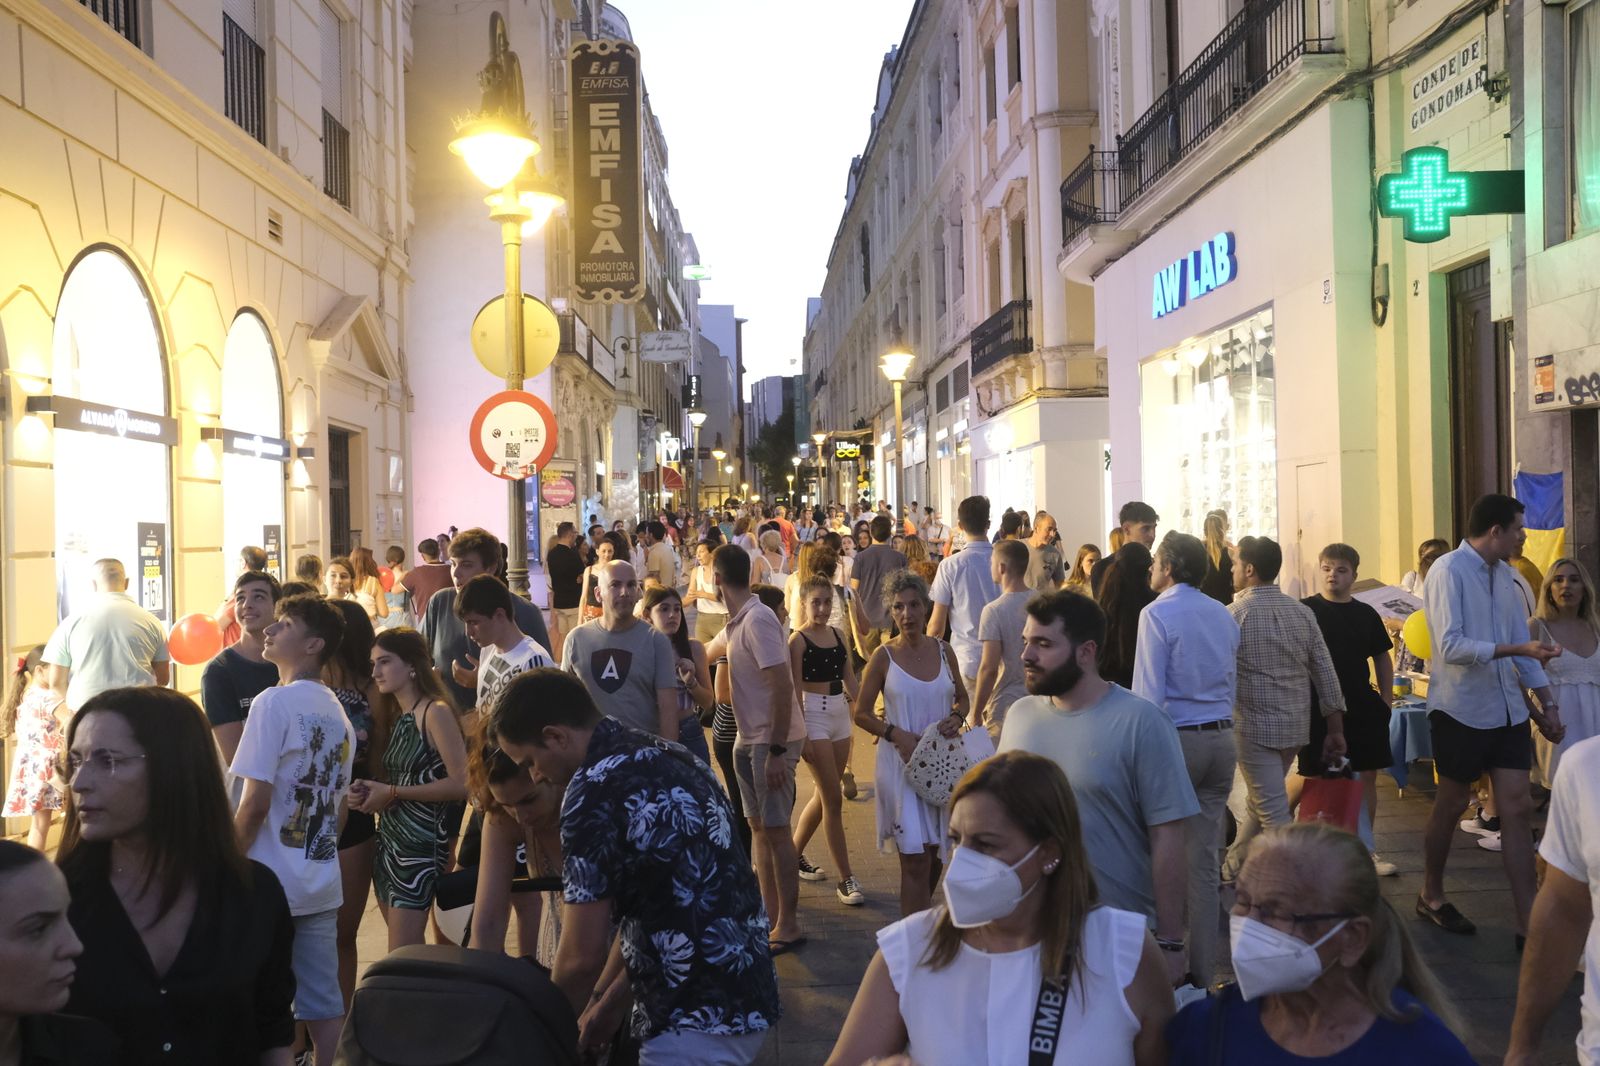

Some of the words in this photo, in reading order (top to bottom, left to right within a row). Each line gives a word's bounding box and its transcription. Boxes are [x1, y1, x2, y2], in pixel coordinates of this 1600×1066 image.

[581, 78, 630, 89] EMFISA
[1413, 56, 1457, 100] CONDE
[1461, 40, 1480, 68] DE
[1411, 71, 1485, 129] GONDOMAR
[589, 102, 625, 254] EMFISA
[580, 262, 635, 273] PROMOTORA
[580, 273, 636, 284] INMOBILIARIA
[1152, 259, 1188, 319] AW
[1187, 231, 1238, 300] LAB
[1413, 279, 1421, 297] 2
[601, 655, 619, 679] A
[481, 664, 522, 715] adidas
